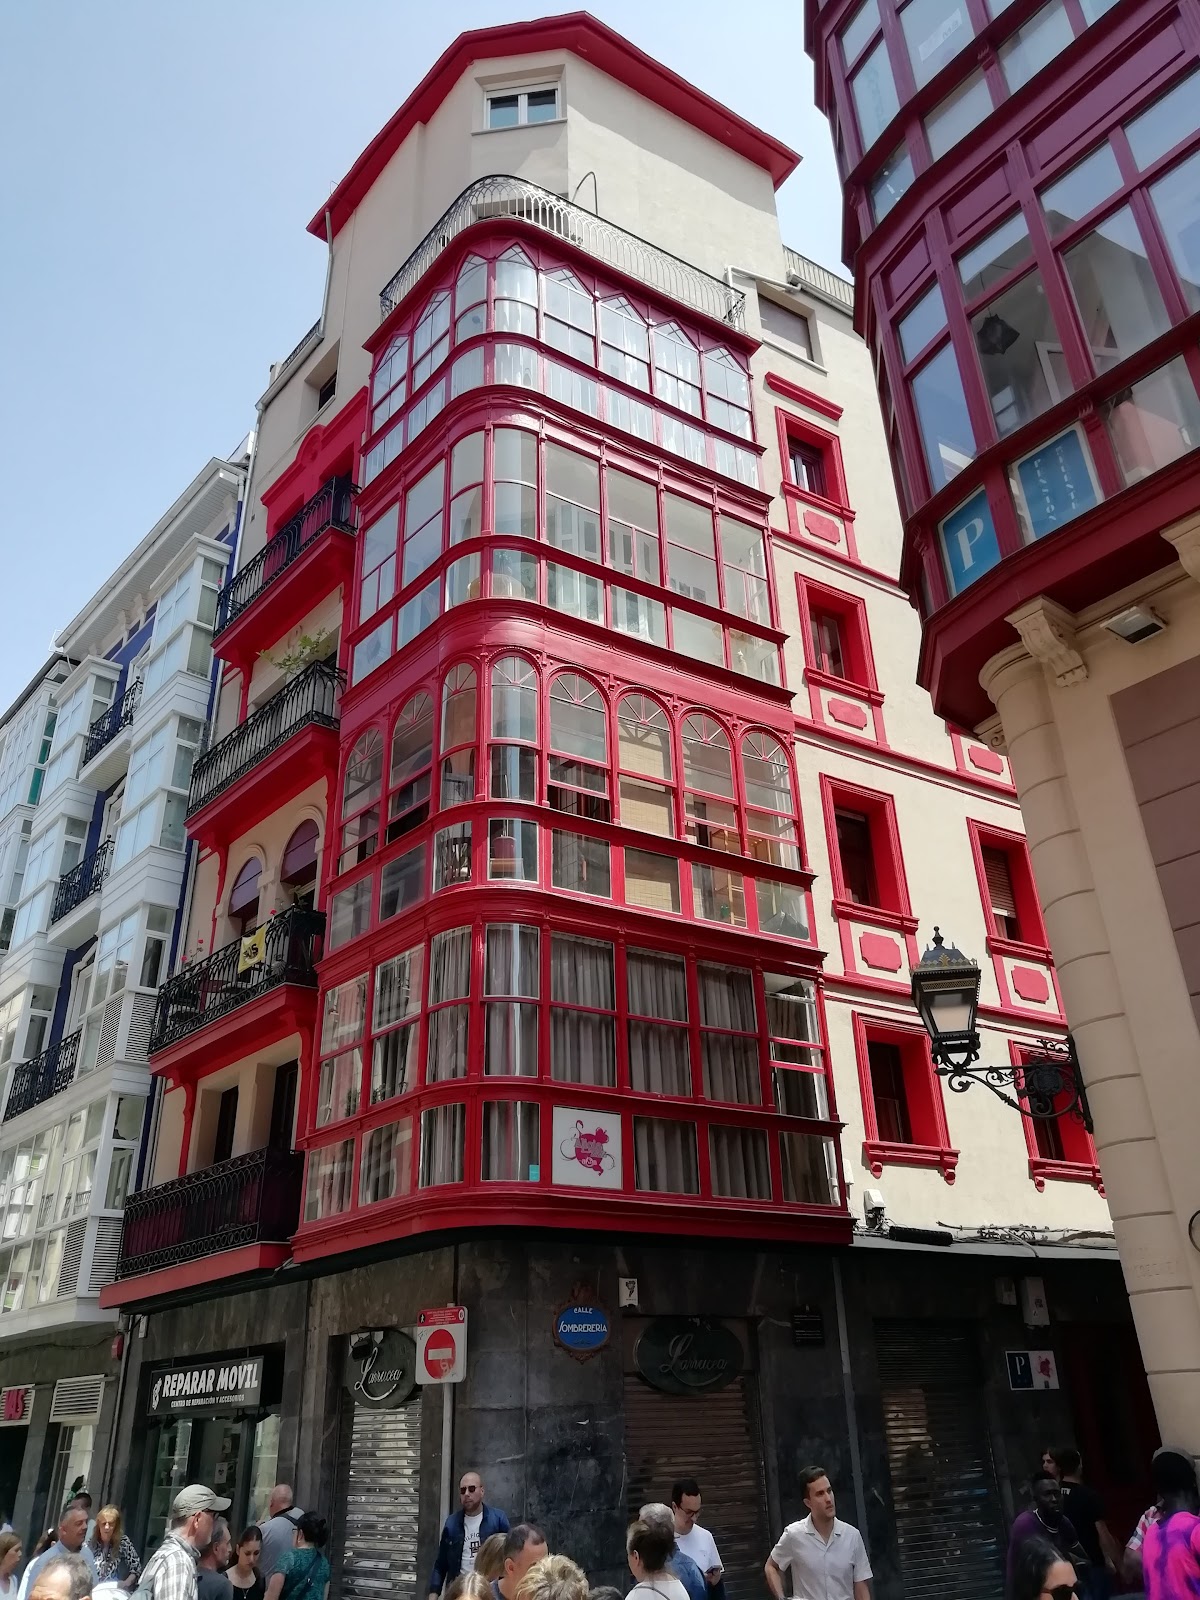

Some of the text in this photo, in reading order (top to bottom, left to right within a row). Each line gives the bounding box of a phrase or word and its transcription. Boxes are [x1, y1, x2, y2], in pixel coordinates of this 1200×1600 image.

[954, 518, 984, 573] P
[573, 1306, 594, 1315] CALLE
[1015, 1356, 1025, 1376] P
[162, 1363, 259, 1398] REPARAR MOVIL
[170, 1400, 186, 1409] CENTRO
[185, 1399, 192, 1407] DE
